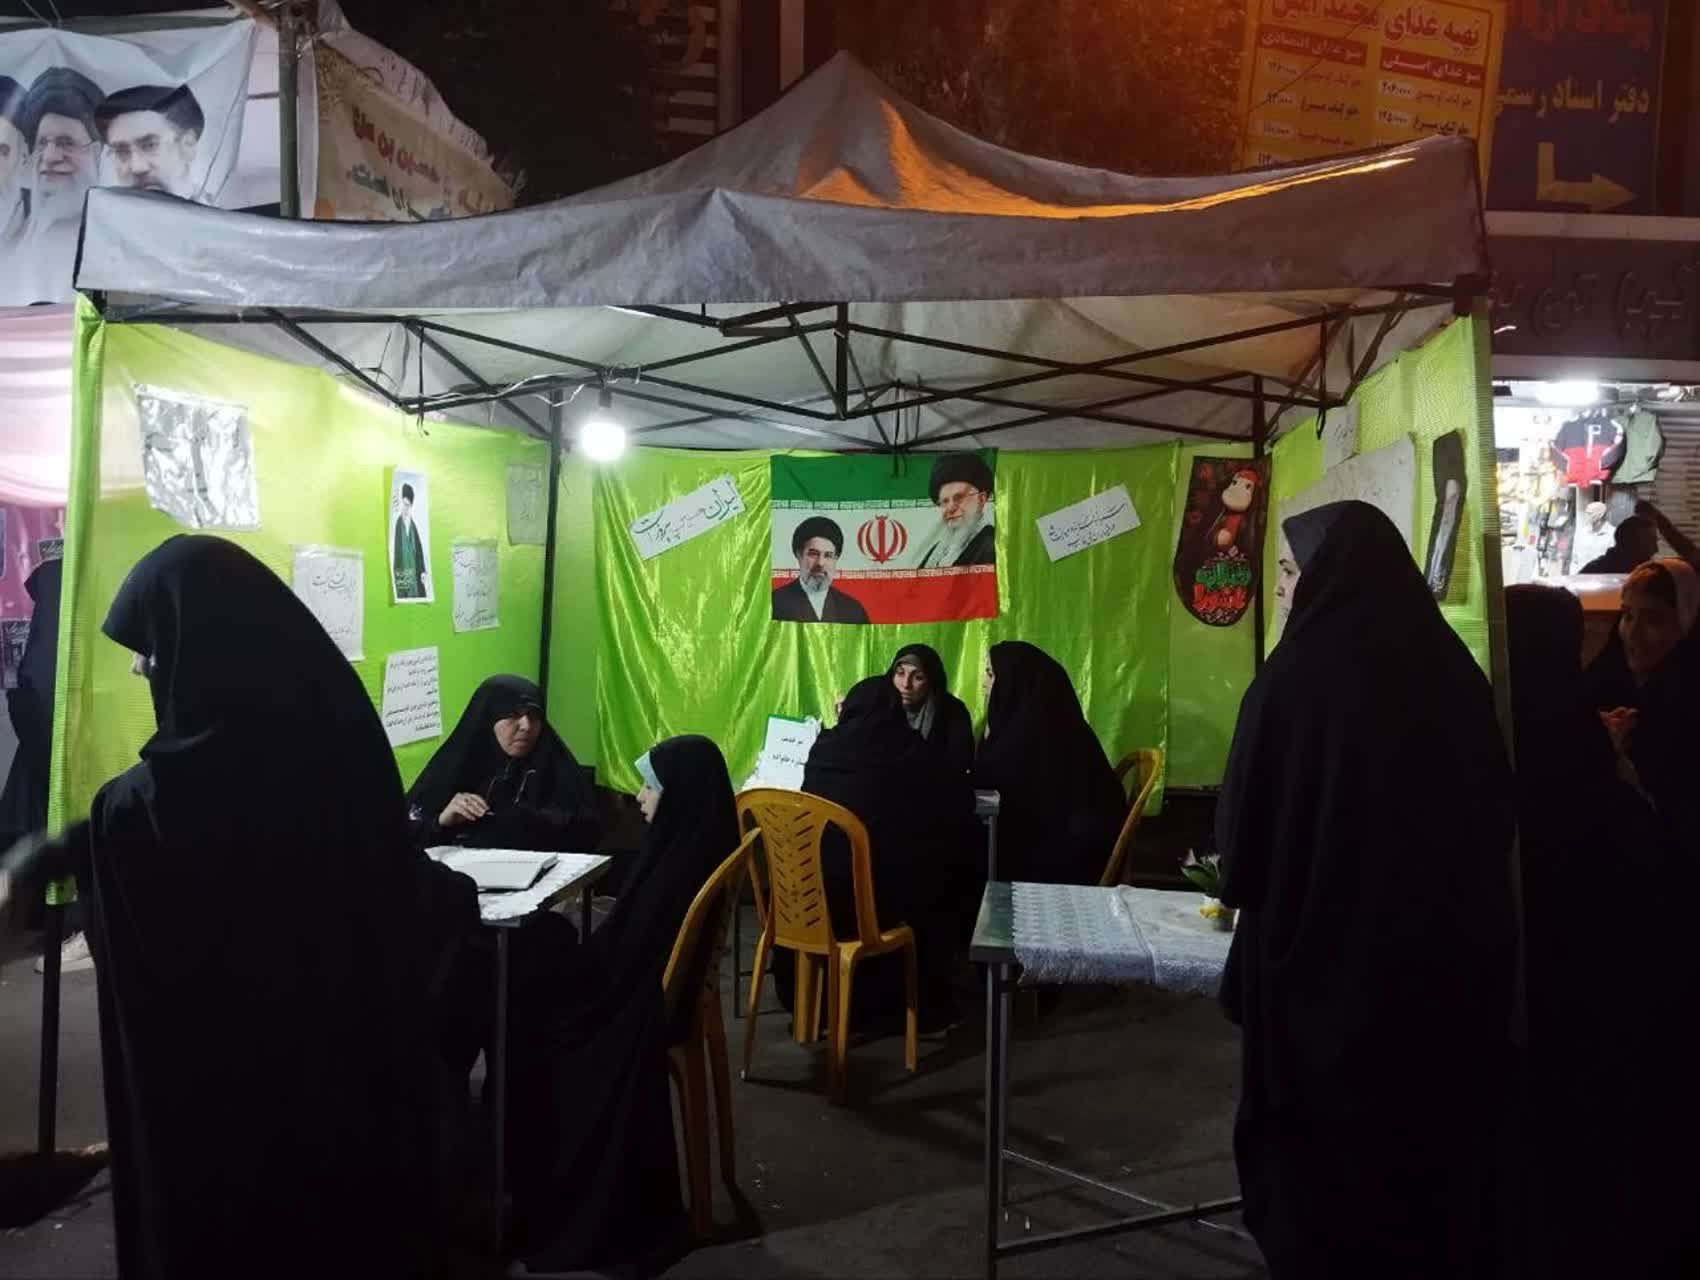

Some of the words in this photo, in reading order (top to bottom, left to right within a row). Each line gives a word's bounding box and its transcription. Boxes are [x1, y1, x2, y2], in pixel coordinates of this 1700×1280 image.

[1384, 5, 1442, 41] غذای
[1552, 74, 1603, 110] اسناد
[1607, 77, 1650, 124] دفتر
[704, 479, 740, 521] ایران
